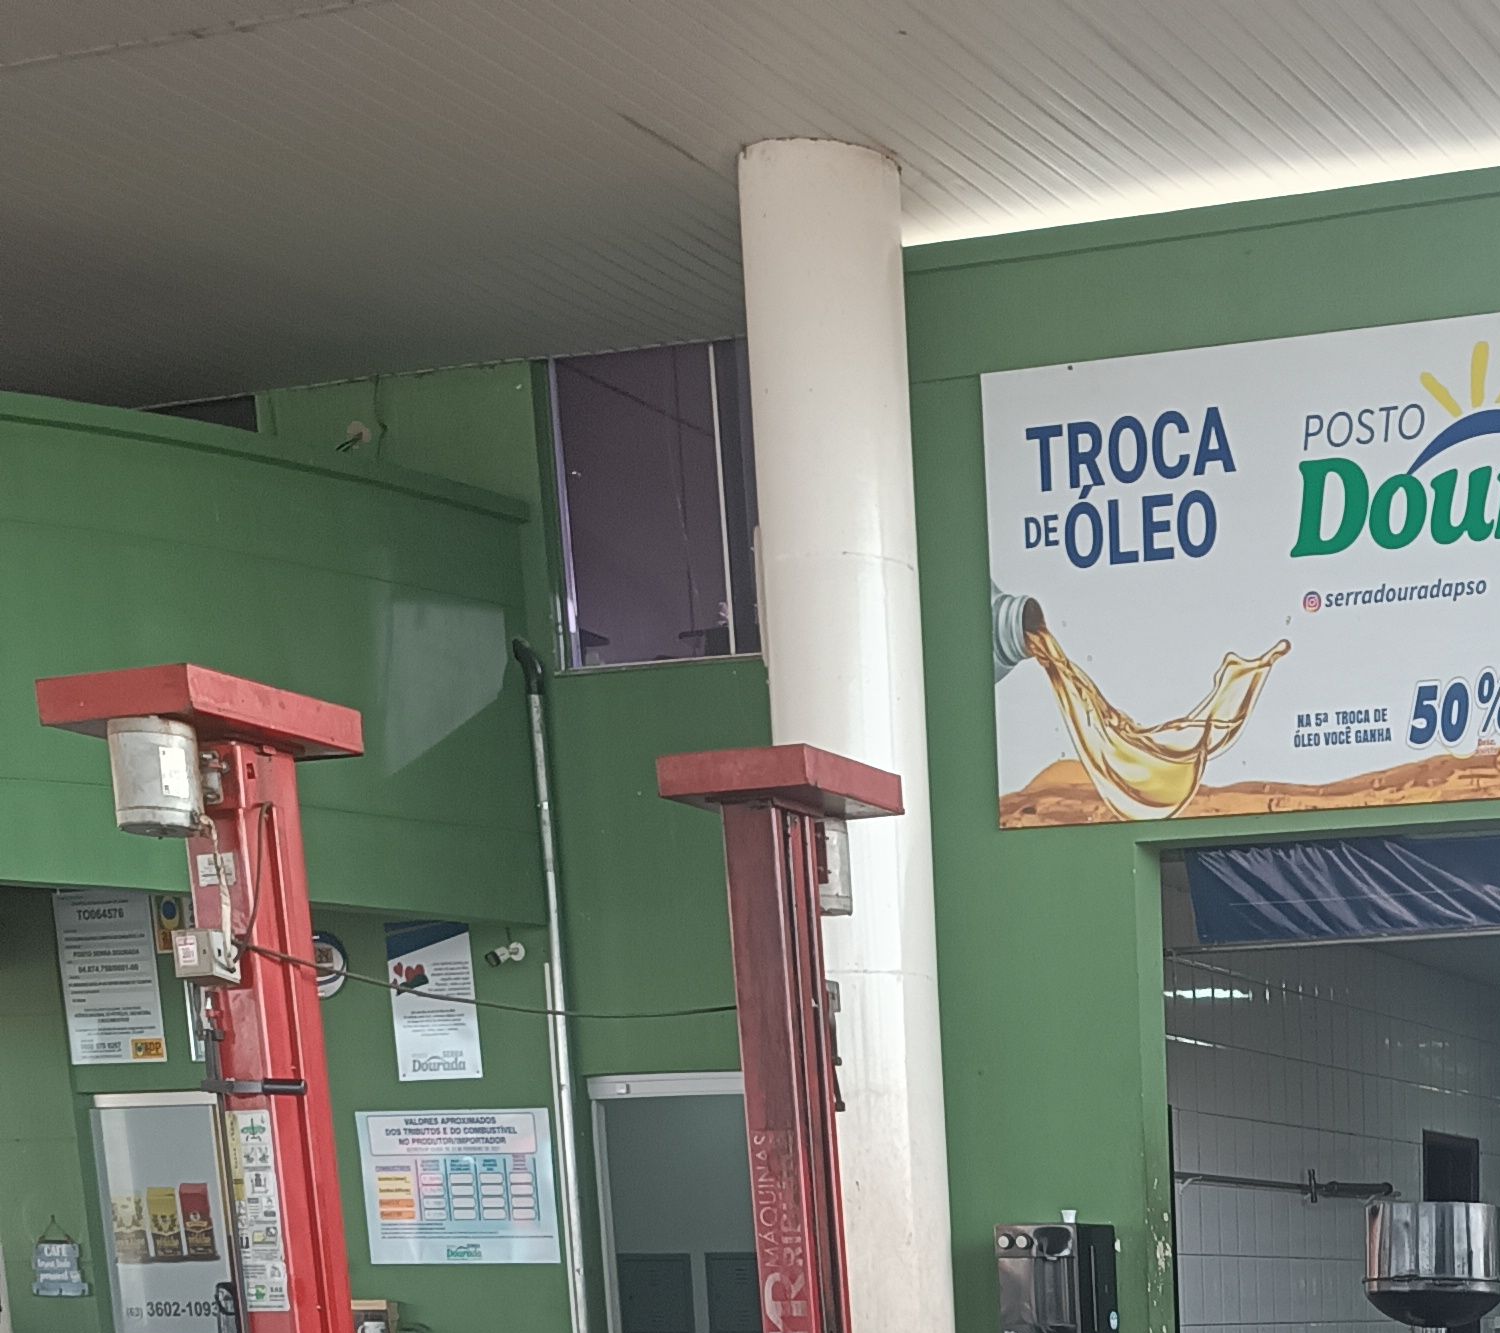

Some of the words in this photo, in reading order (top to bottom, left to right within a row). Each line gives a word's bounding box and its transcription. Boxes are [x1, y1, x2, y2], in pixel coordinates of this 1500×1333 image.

[1303, 403, 1426, 451] POSTO
[1026, 407, 1237, 492] TROCA
[1025, 513, 1059, 550] DE
[1064, 483, 1217, 569] ÓLEO
[1324, 575, 1487, 610] serradouradapso
[1297, 713, 1311, 728] NA
[1336, 709, 1370, 724] TROCA
[1374, 708, 1388, 723] DE
[1294, 730, 1320, 748] ÓLEO
[1324, 726, 1351, 745] VOCÊ
[1355, 728, 1392, 743] GANHA
[412, 1057, 466, 1072] Dourada
[404, 1117, 438, 1126] VALORES
